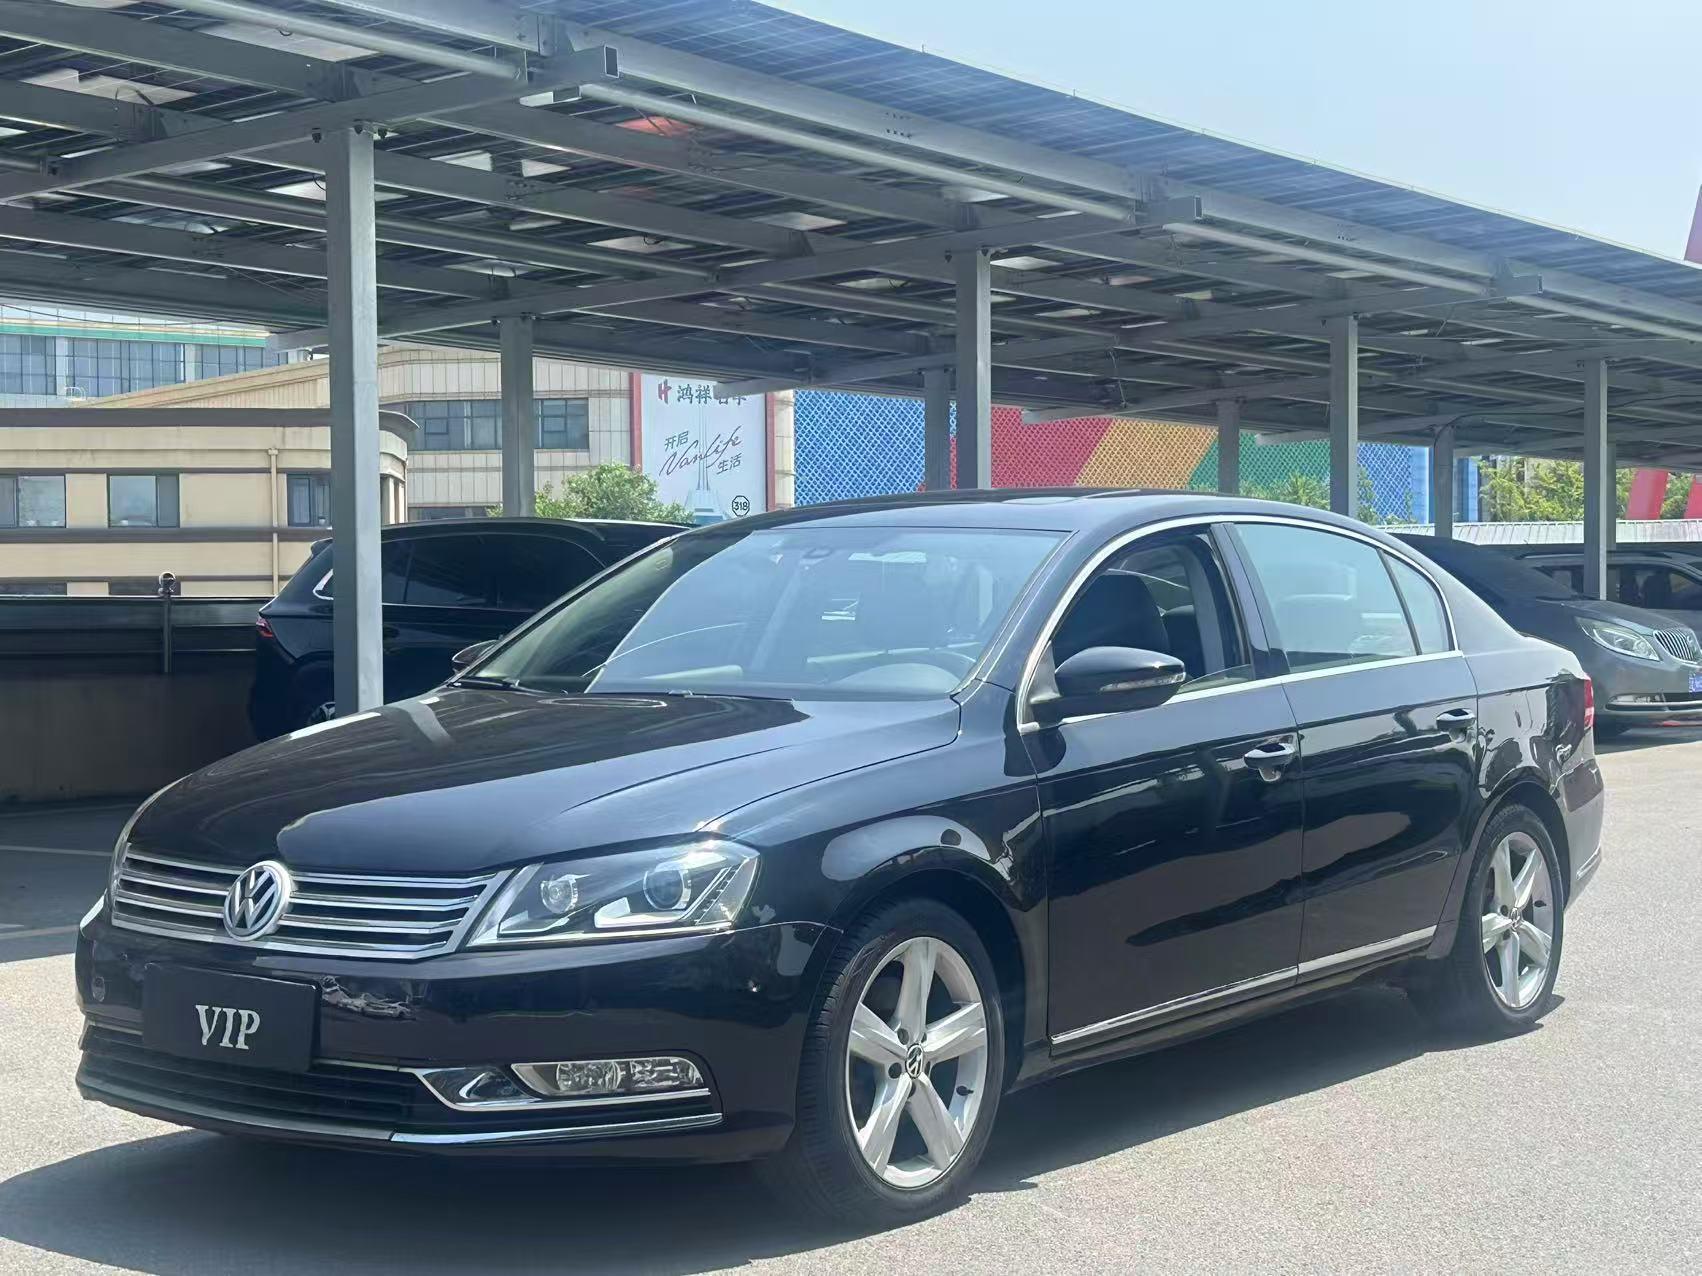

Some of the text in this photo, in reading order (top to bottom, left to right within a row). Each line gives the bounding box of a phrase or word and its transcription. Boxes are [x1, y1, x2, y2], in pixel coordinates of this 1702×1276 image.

[664, 431, 689, 452] 开启
[716, 453, 742, 475] 生活
[734, 501, 748, 511] 318
[195, 1004, 261, 1050] VIP
